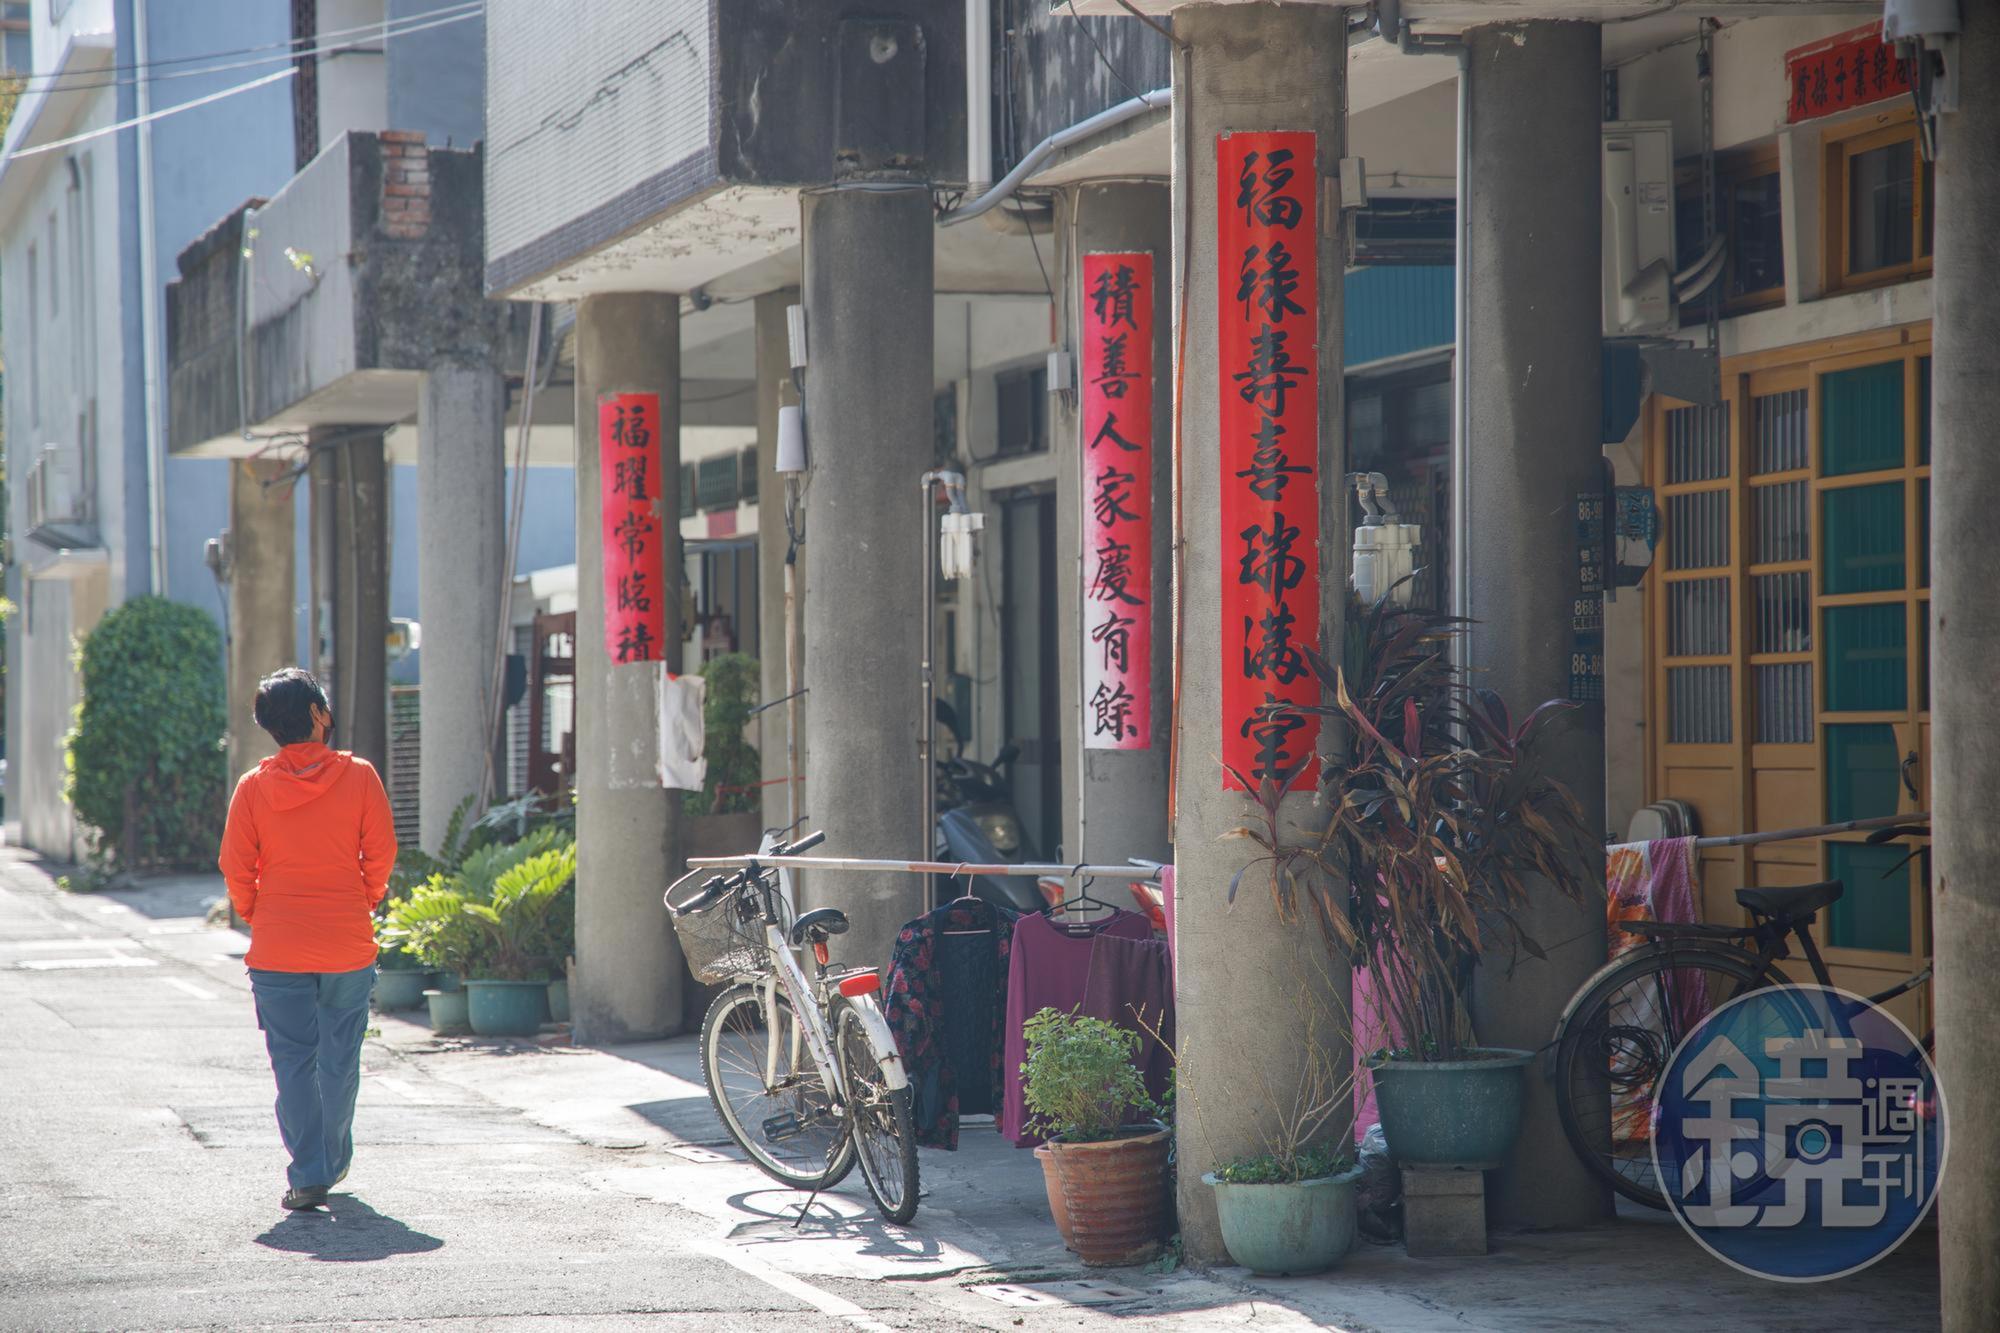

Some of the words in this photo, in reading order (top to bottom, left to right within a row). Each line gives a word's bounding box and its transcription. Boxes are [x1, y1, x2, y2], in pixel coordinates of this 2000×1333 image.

[1088, 263, 1146, 742] 積善人家慶有餘
